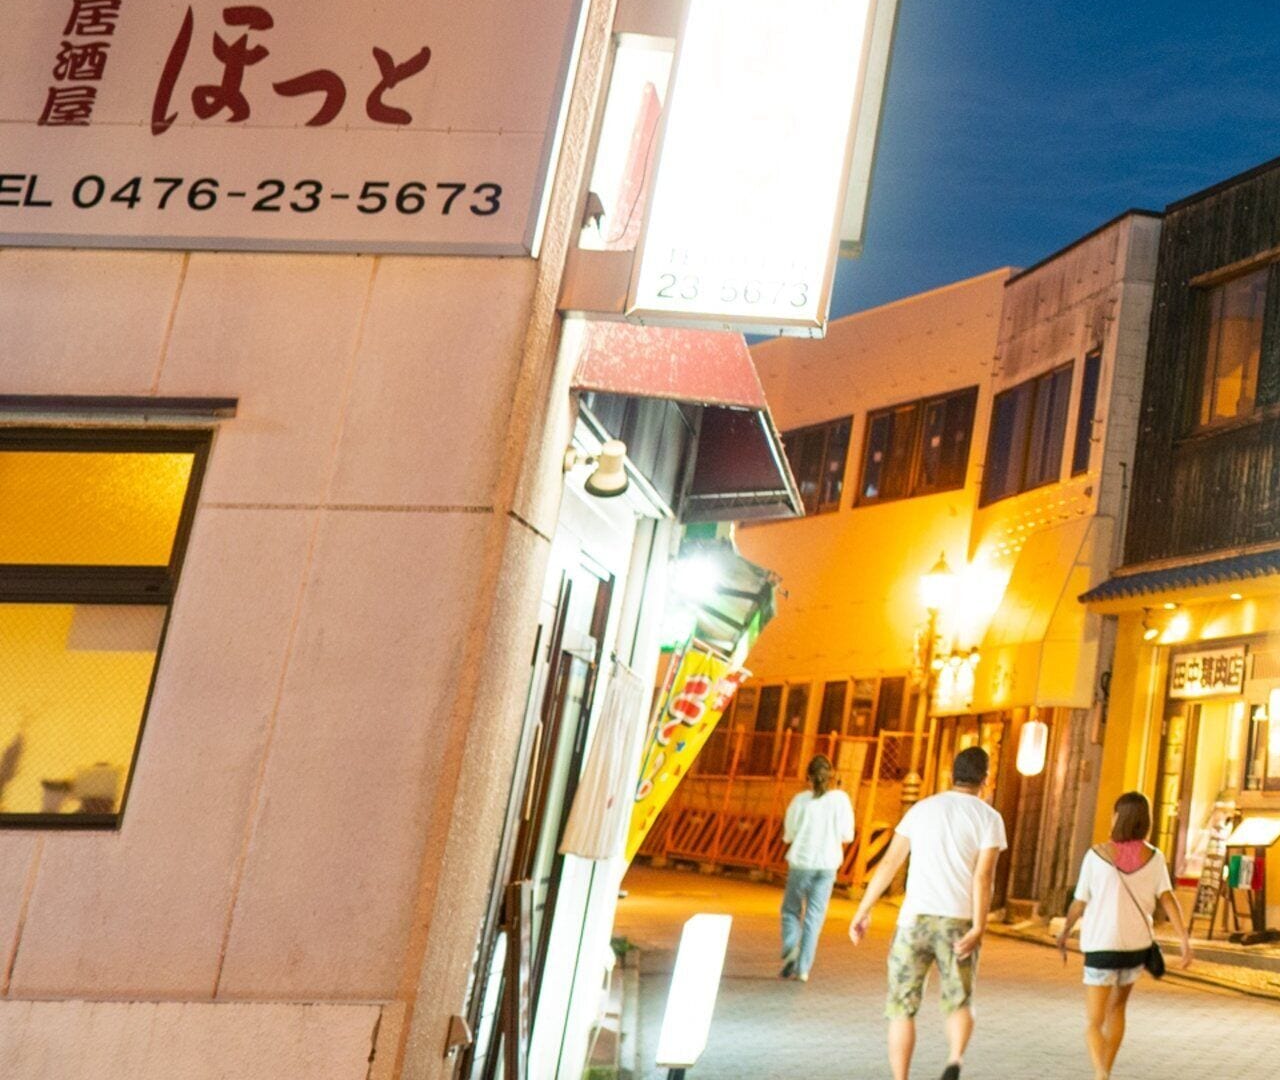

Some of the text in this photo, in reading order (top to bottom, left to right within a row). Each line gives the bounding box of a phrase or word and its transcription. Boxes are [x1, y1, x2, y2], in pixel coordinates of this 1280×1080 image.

[150, 4, 432, 137] ほっと
[71, 173, 504, 217] 0476-23-5673
